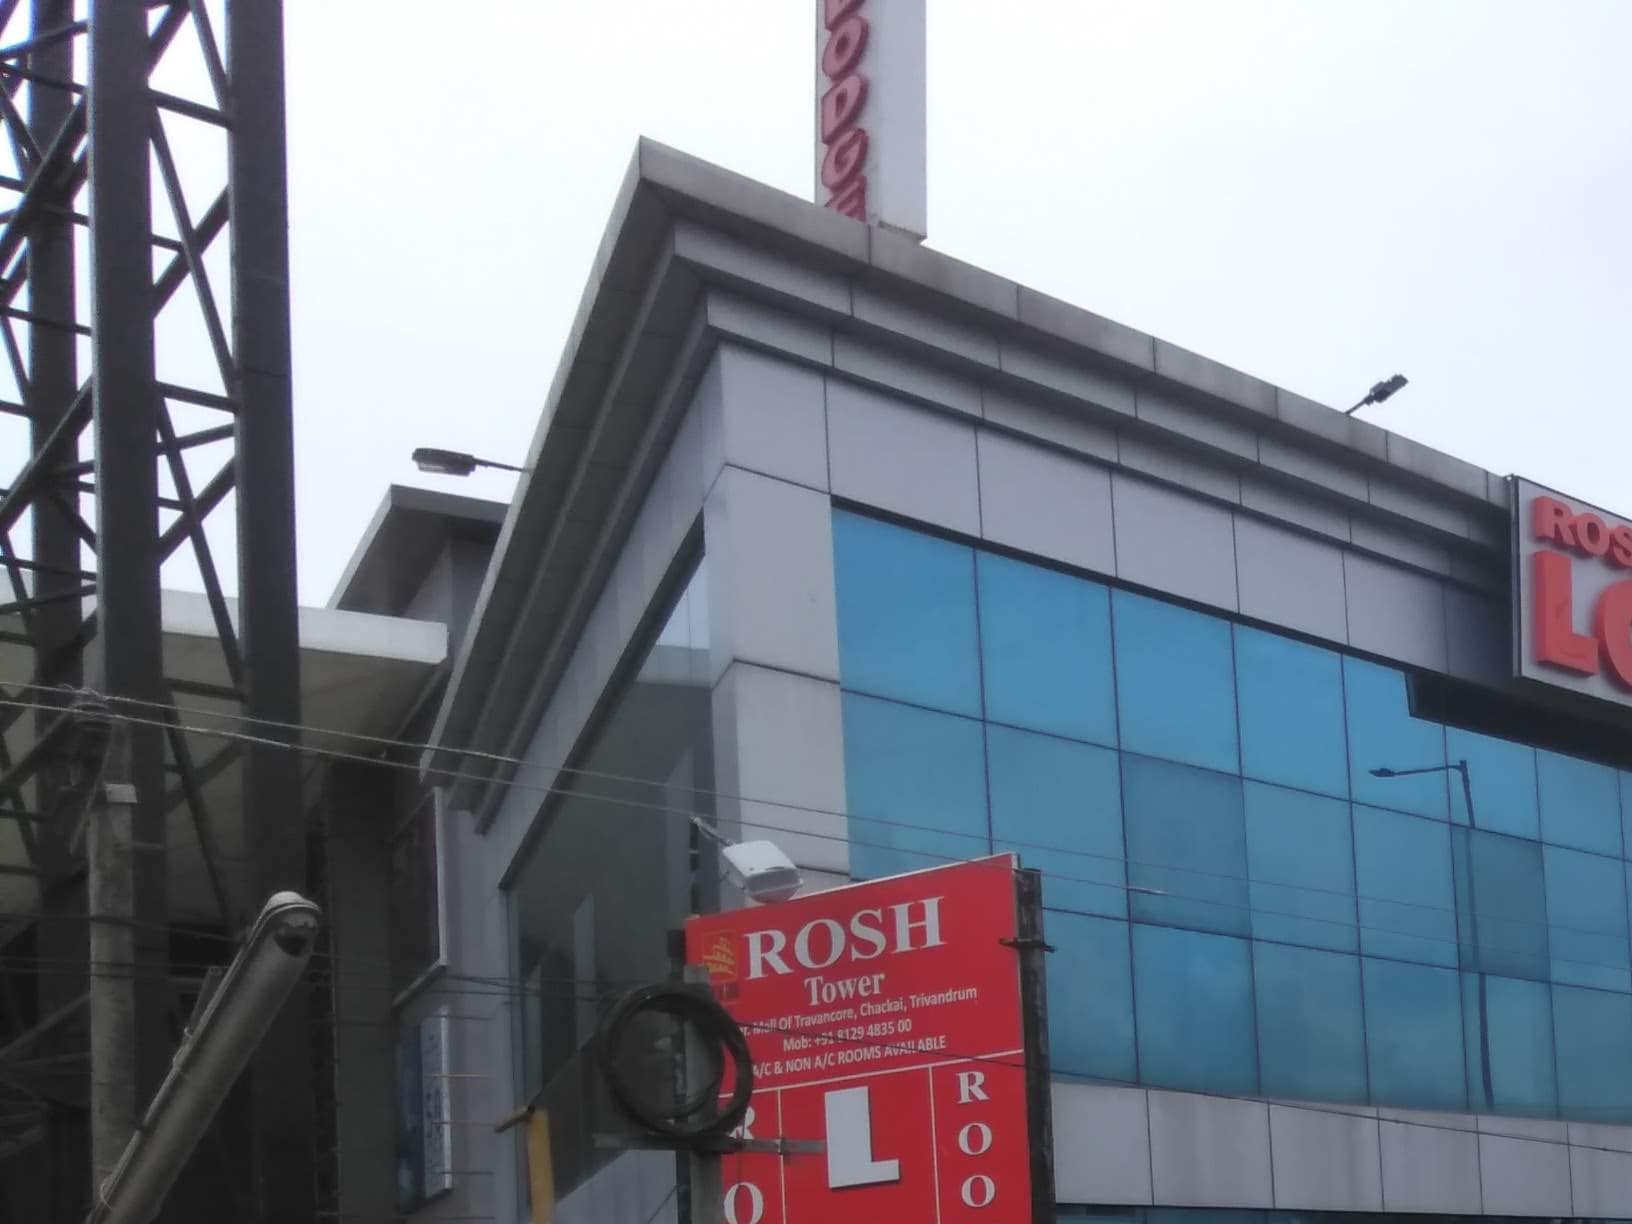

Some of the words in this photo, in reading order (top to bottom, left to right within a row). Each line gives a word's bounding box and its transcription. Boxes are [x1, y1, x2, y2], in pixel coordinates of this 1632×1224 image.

[745, 896, 948, 980] ROSH
[804, 972, 885, 1006] Tower
[752, 1017, 777, 1036] Mall
[794, 1007, 857, 1028] Travancore,
[909, 987, 978, 1009] Trivandrum
[774, 1061, 783, 1075] &
[786, 1057, 811, 1073] NON
[814, 1052, 835, 1070] A/C
[838, 1046, 881, 1065] ROOMS
[884, 1035, 947, 1057] AVAILABLE
[783, 1035, 812, 1052] Mob:
[898, 1018, 912, 1033] 00
